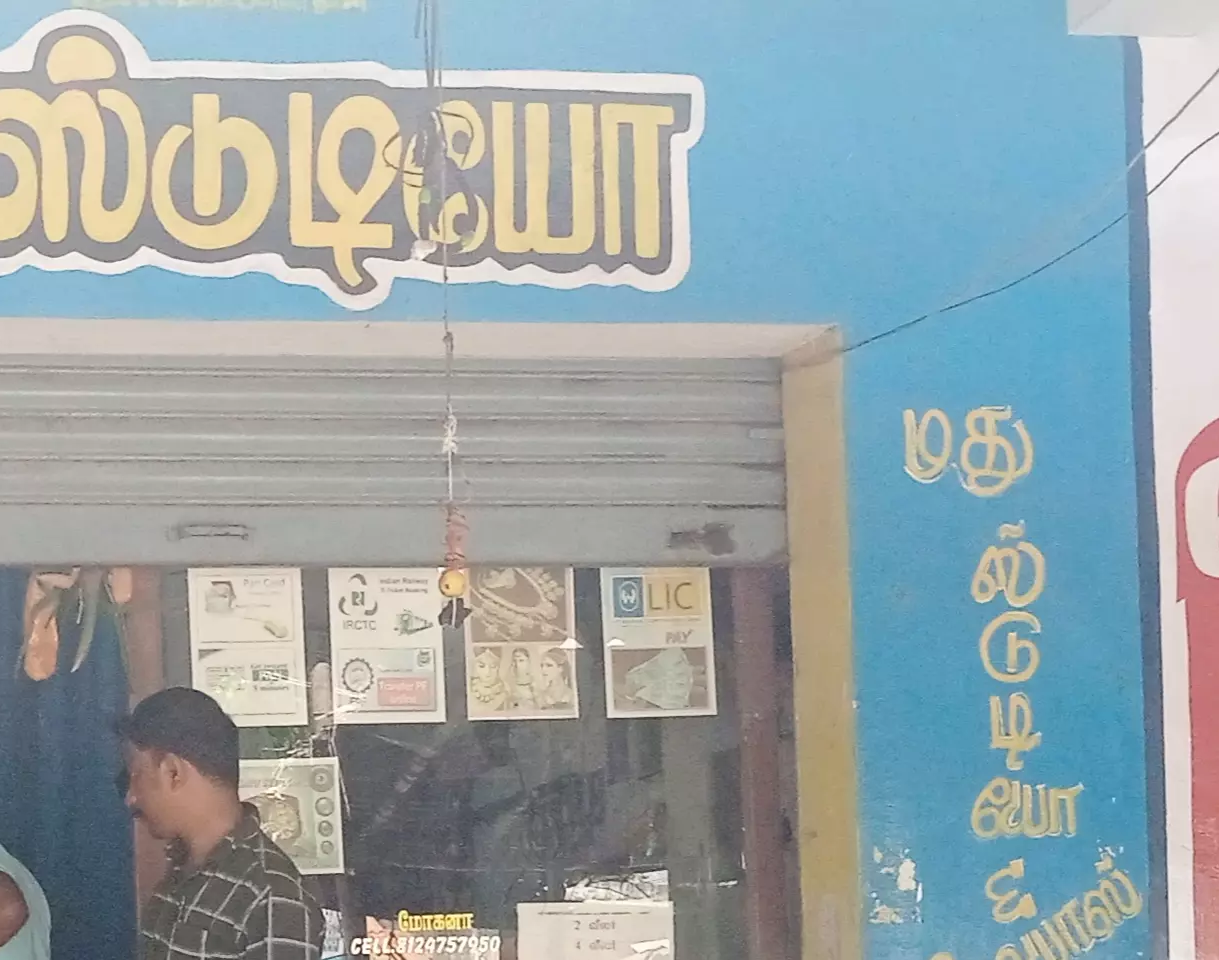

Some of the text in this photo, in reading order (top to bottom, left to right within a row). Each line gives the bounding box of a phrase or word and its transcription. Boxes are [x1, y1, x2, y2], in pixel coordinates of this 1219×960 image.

[903, 404, 1033, 498] மது
[647, 582, 693, 610] LIC
[342, 620, 377, 630] IRCTC
[397, 910, 474, 932] மோகனா
